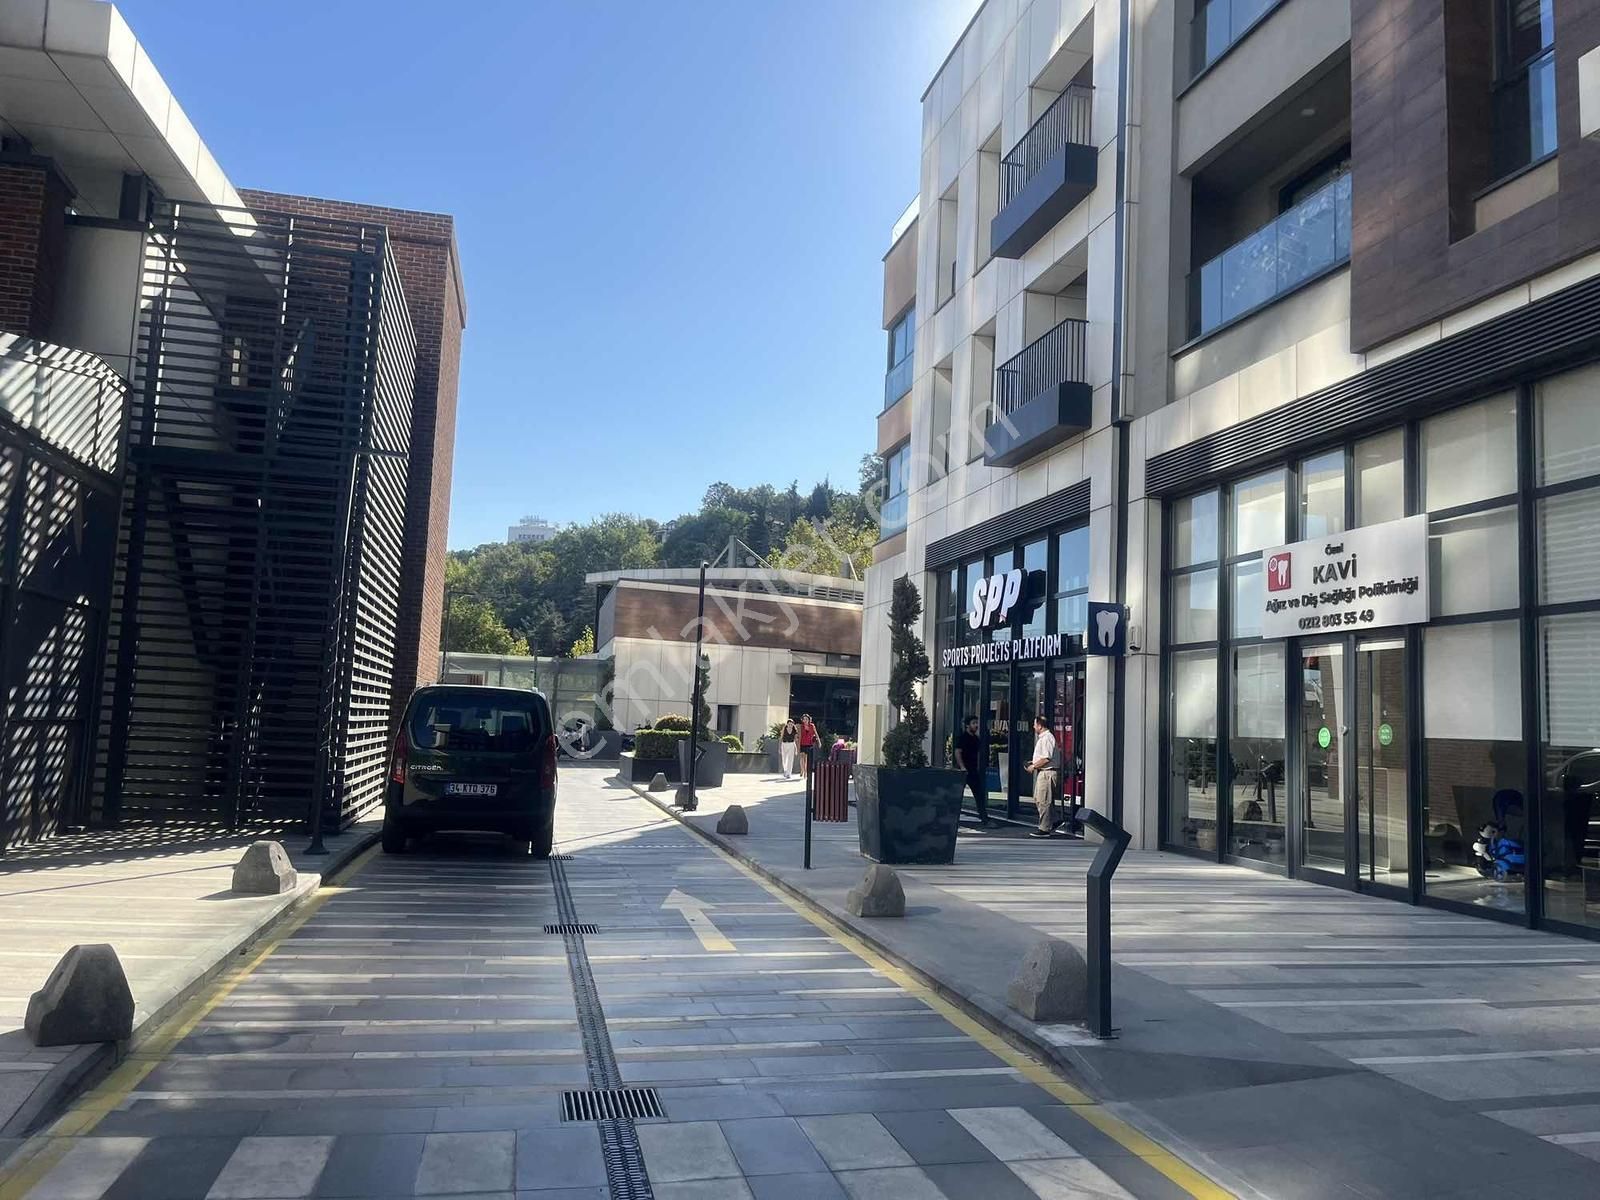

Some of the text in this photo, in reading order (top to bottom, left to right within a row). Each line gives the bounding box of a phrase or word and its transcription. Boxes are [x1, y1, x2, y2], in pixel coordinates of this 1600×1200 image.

[1312, 553, 1357, 585] KAVİ
[969, 568, 1022, 630] SPP
[1266, 576, 1419, 613] Ağız ve Diş Sağlığı Polikliniği
[1299, 608, 1375, 630] 0212 803 55 49
[942, 632, 1062, 668] SPORTS PROJECTS PLATFORM
[450, 783, 460, 793] 34
